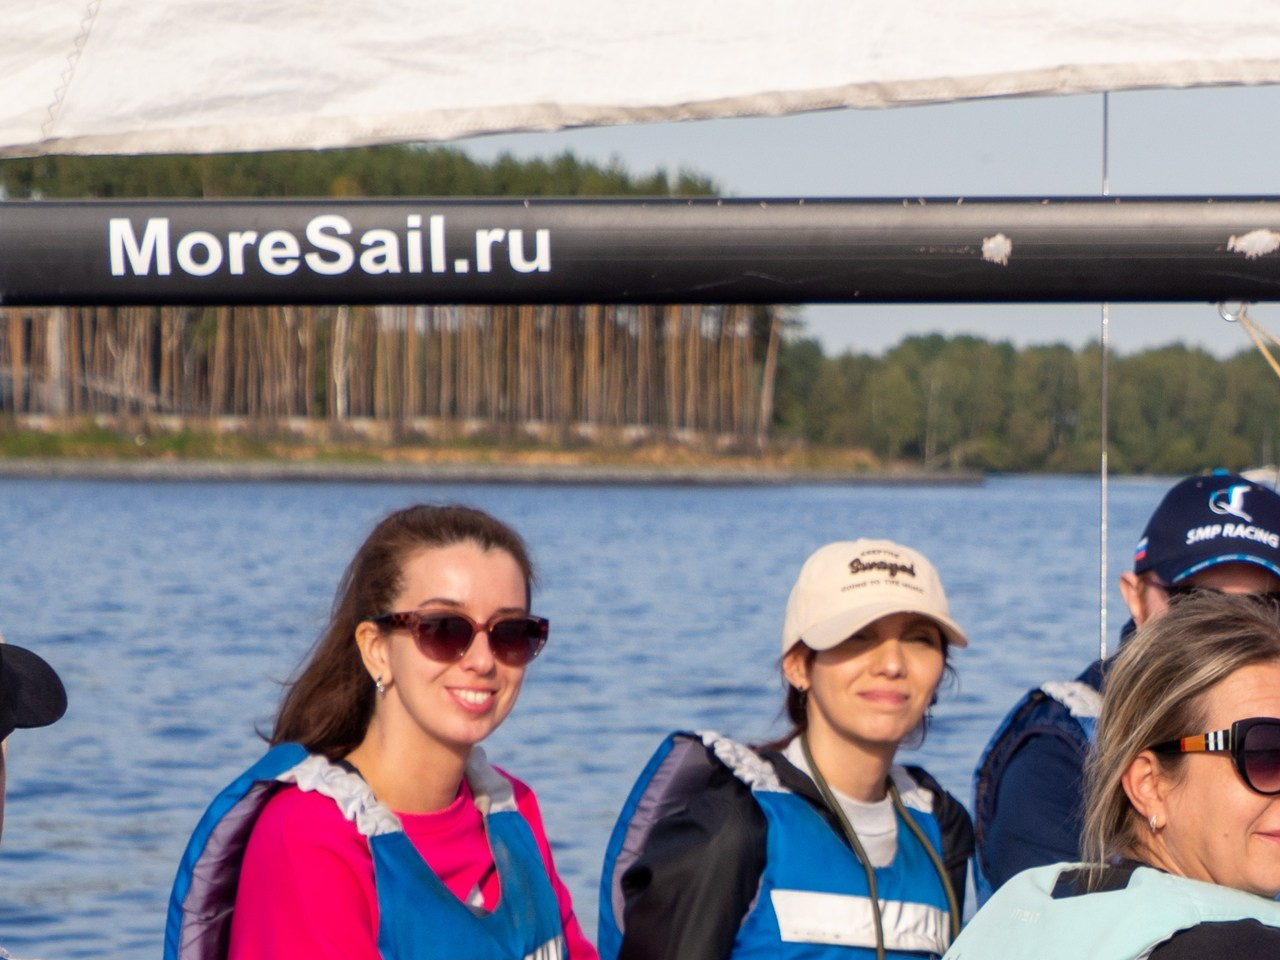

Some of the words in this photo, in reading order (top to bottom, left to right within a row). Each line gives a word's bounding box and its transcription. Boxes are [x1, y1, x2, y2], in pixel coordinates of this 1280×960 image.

[109, 214, 552, 276] MoreSail.ru
[1185, 524, 1221, 545] SMP
[1222, 522, 1280, 549] RACING
